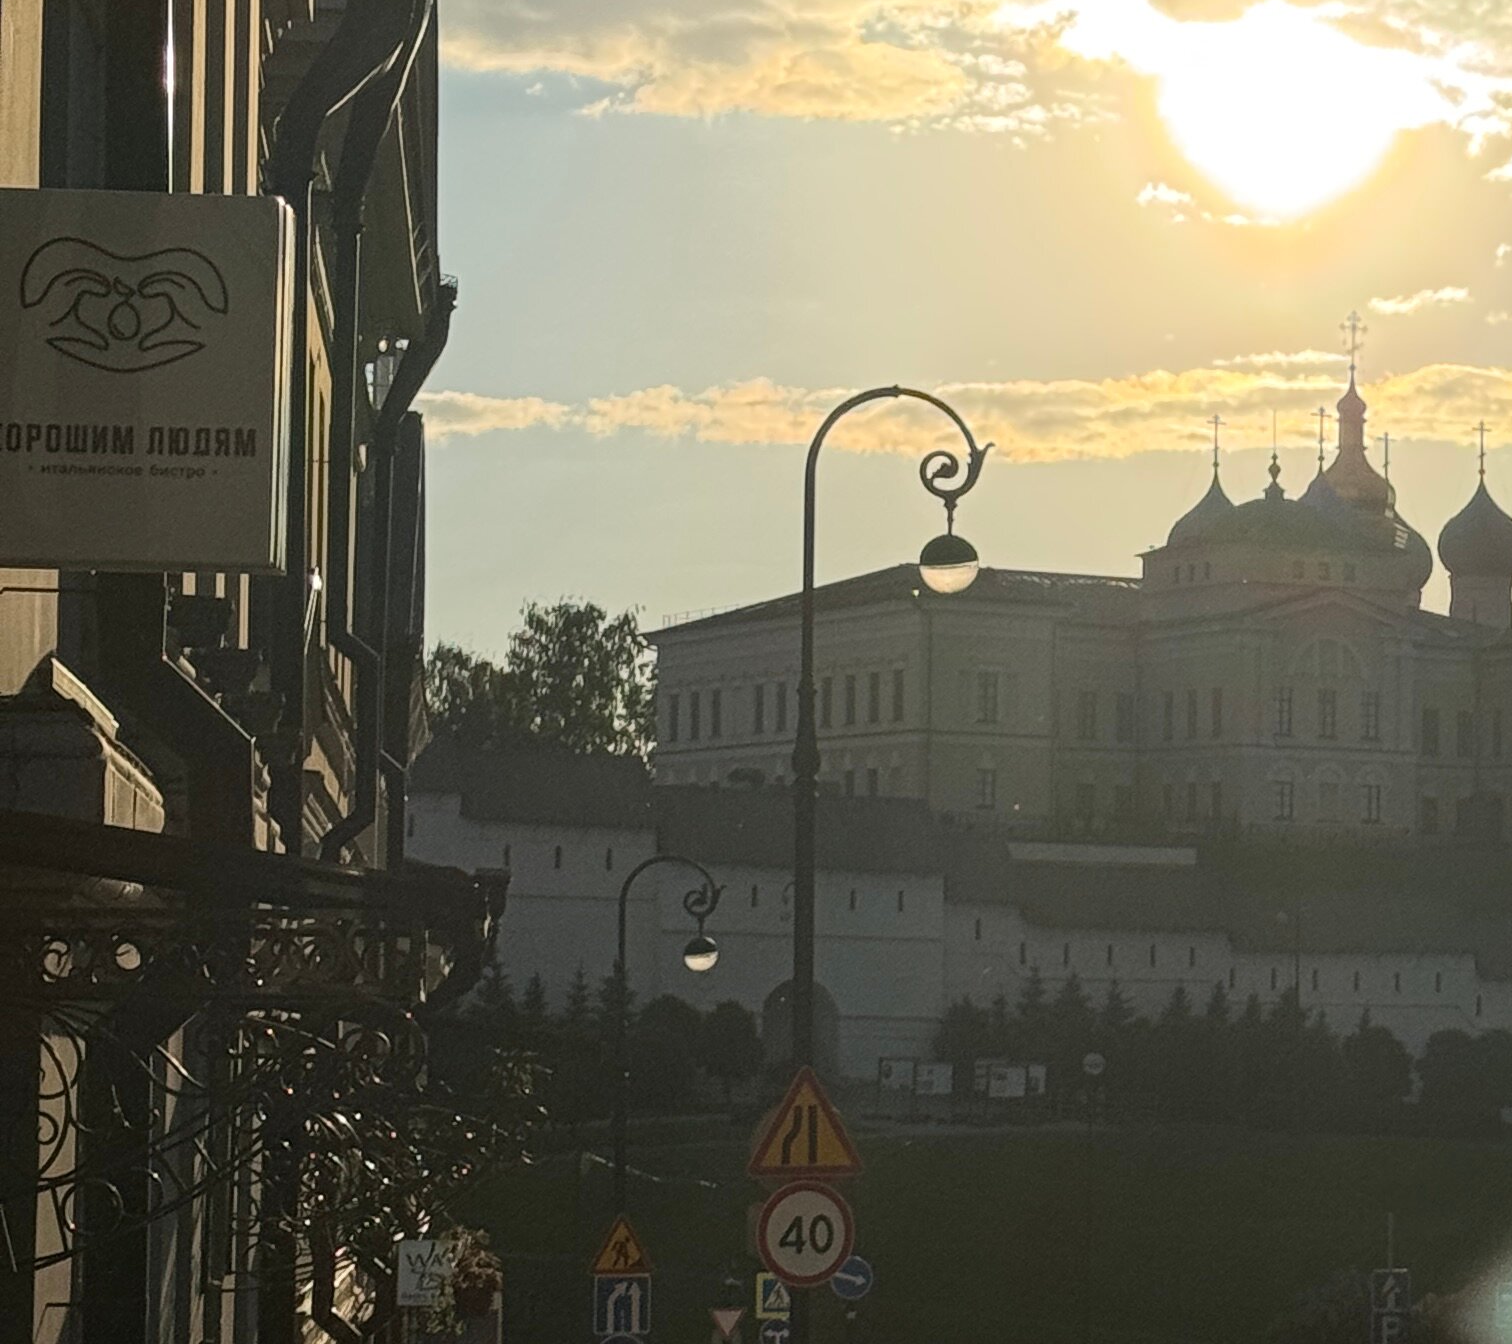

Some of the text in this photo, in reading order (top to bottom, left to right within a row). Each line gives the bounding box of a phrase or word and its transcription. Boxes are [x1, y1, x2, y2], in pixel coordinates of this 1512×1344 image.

[0, 422, 257, 457] ОРОШИМ ЛЮДЯМ
[40, 463, 206, 479] итальянское бистро
[779, 1213, 835, 1255] 40
